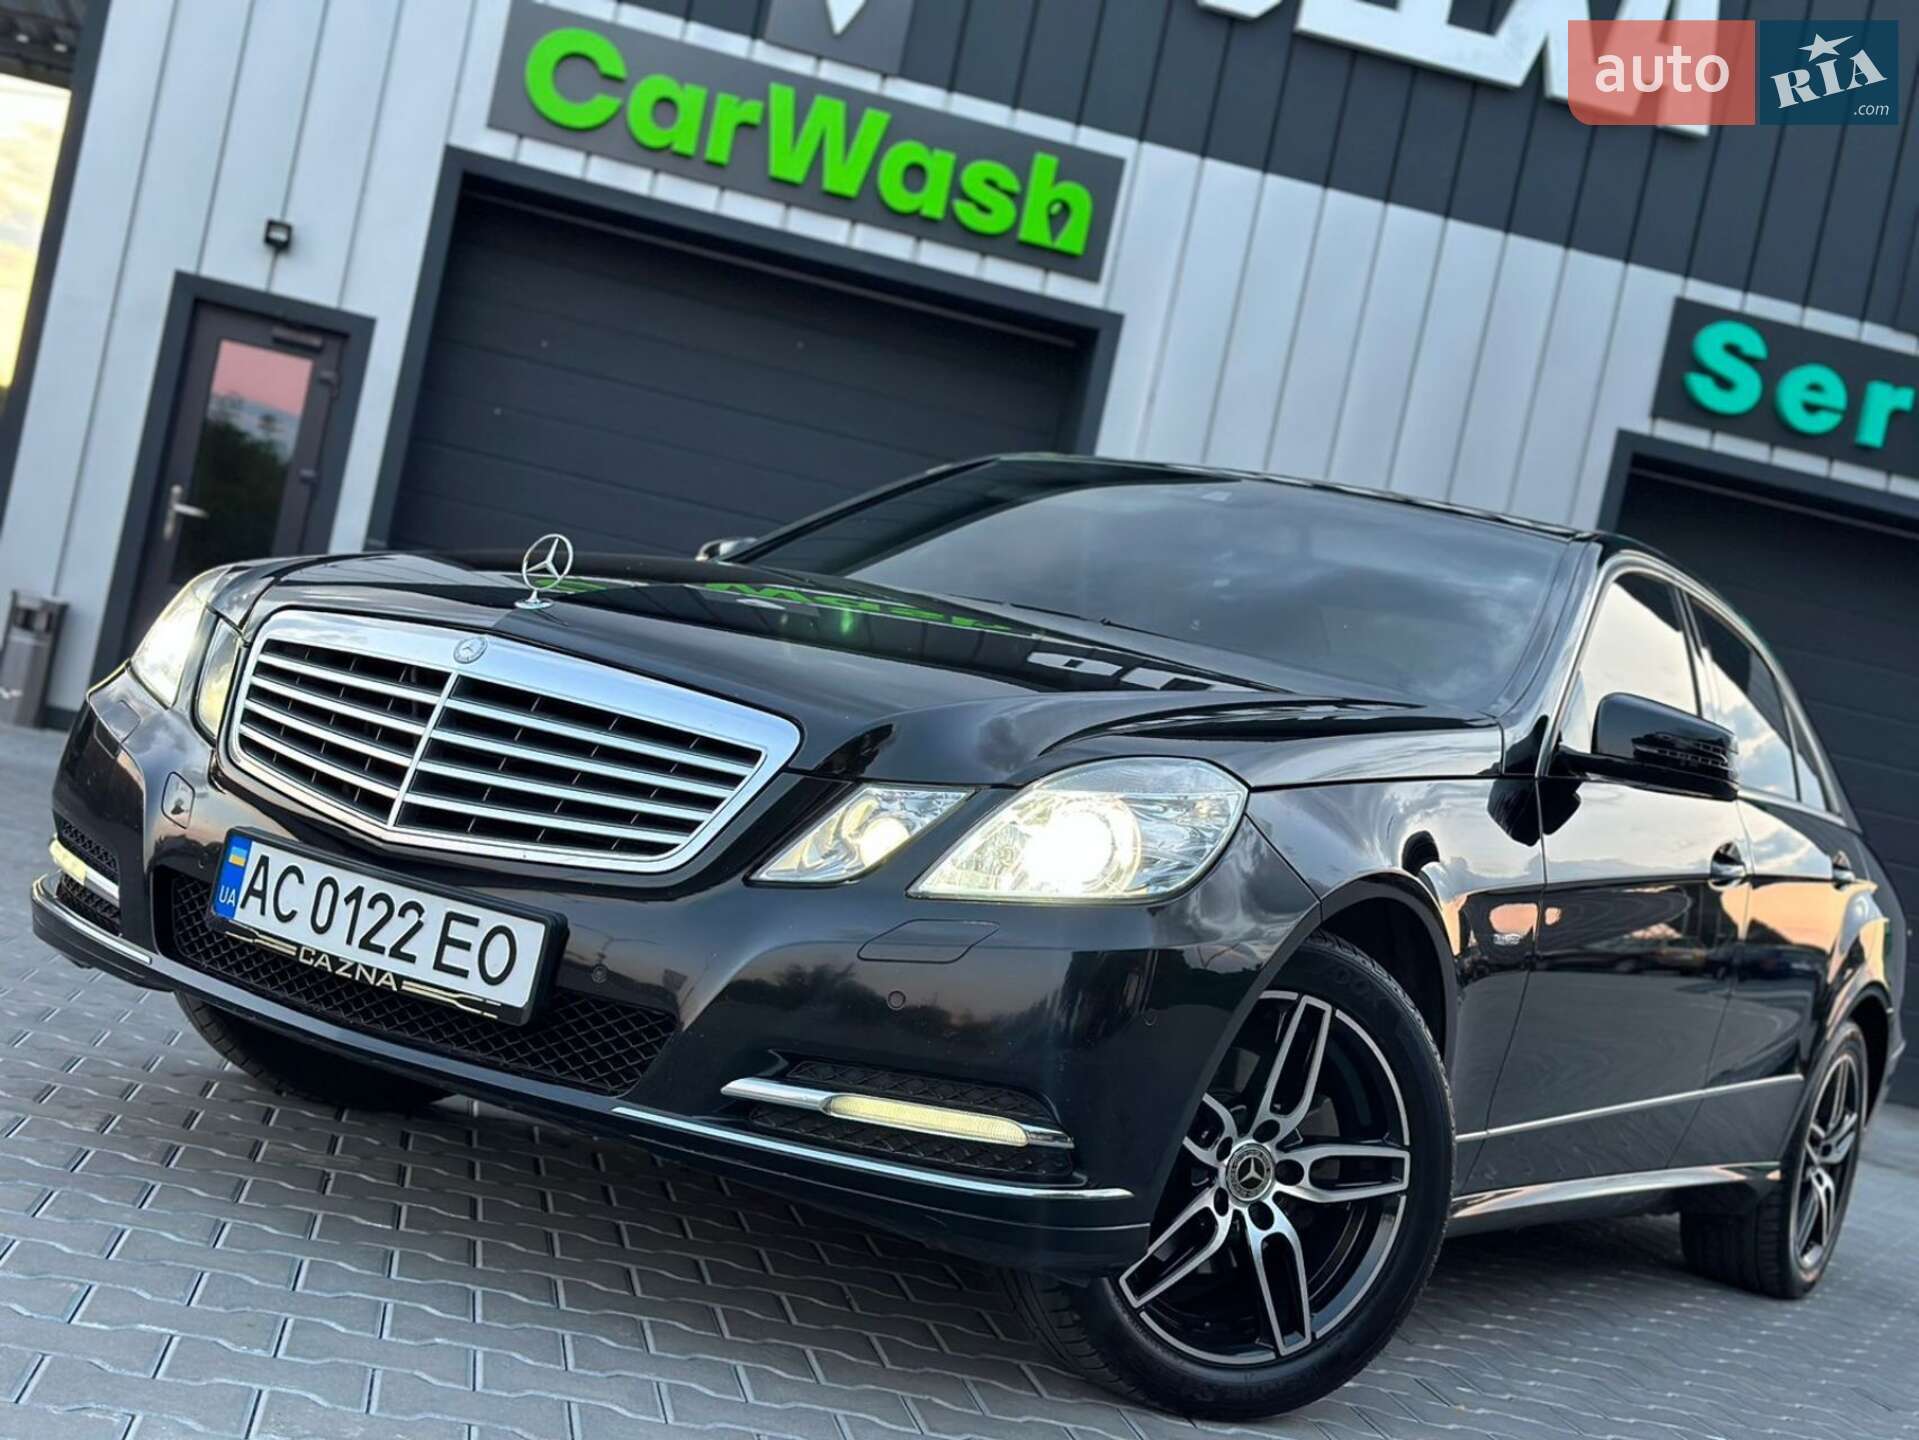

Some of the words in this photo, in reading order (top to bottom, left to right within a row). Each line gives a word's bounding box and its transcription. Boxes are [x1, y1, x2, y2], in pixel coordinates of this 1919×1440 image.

[525, 27, 1093, 256] CarWash
[1684, 320, 1915, 448] Ser
[219, 885, 236, 907] UA
[240, 854, 304, 923] AC
[310, 876, 425, 964] 0122
[432, 910, 518, 986] EO
